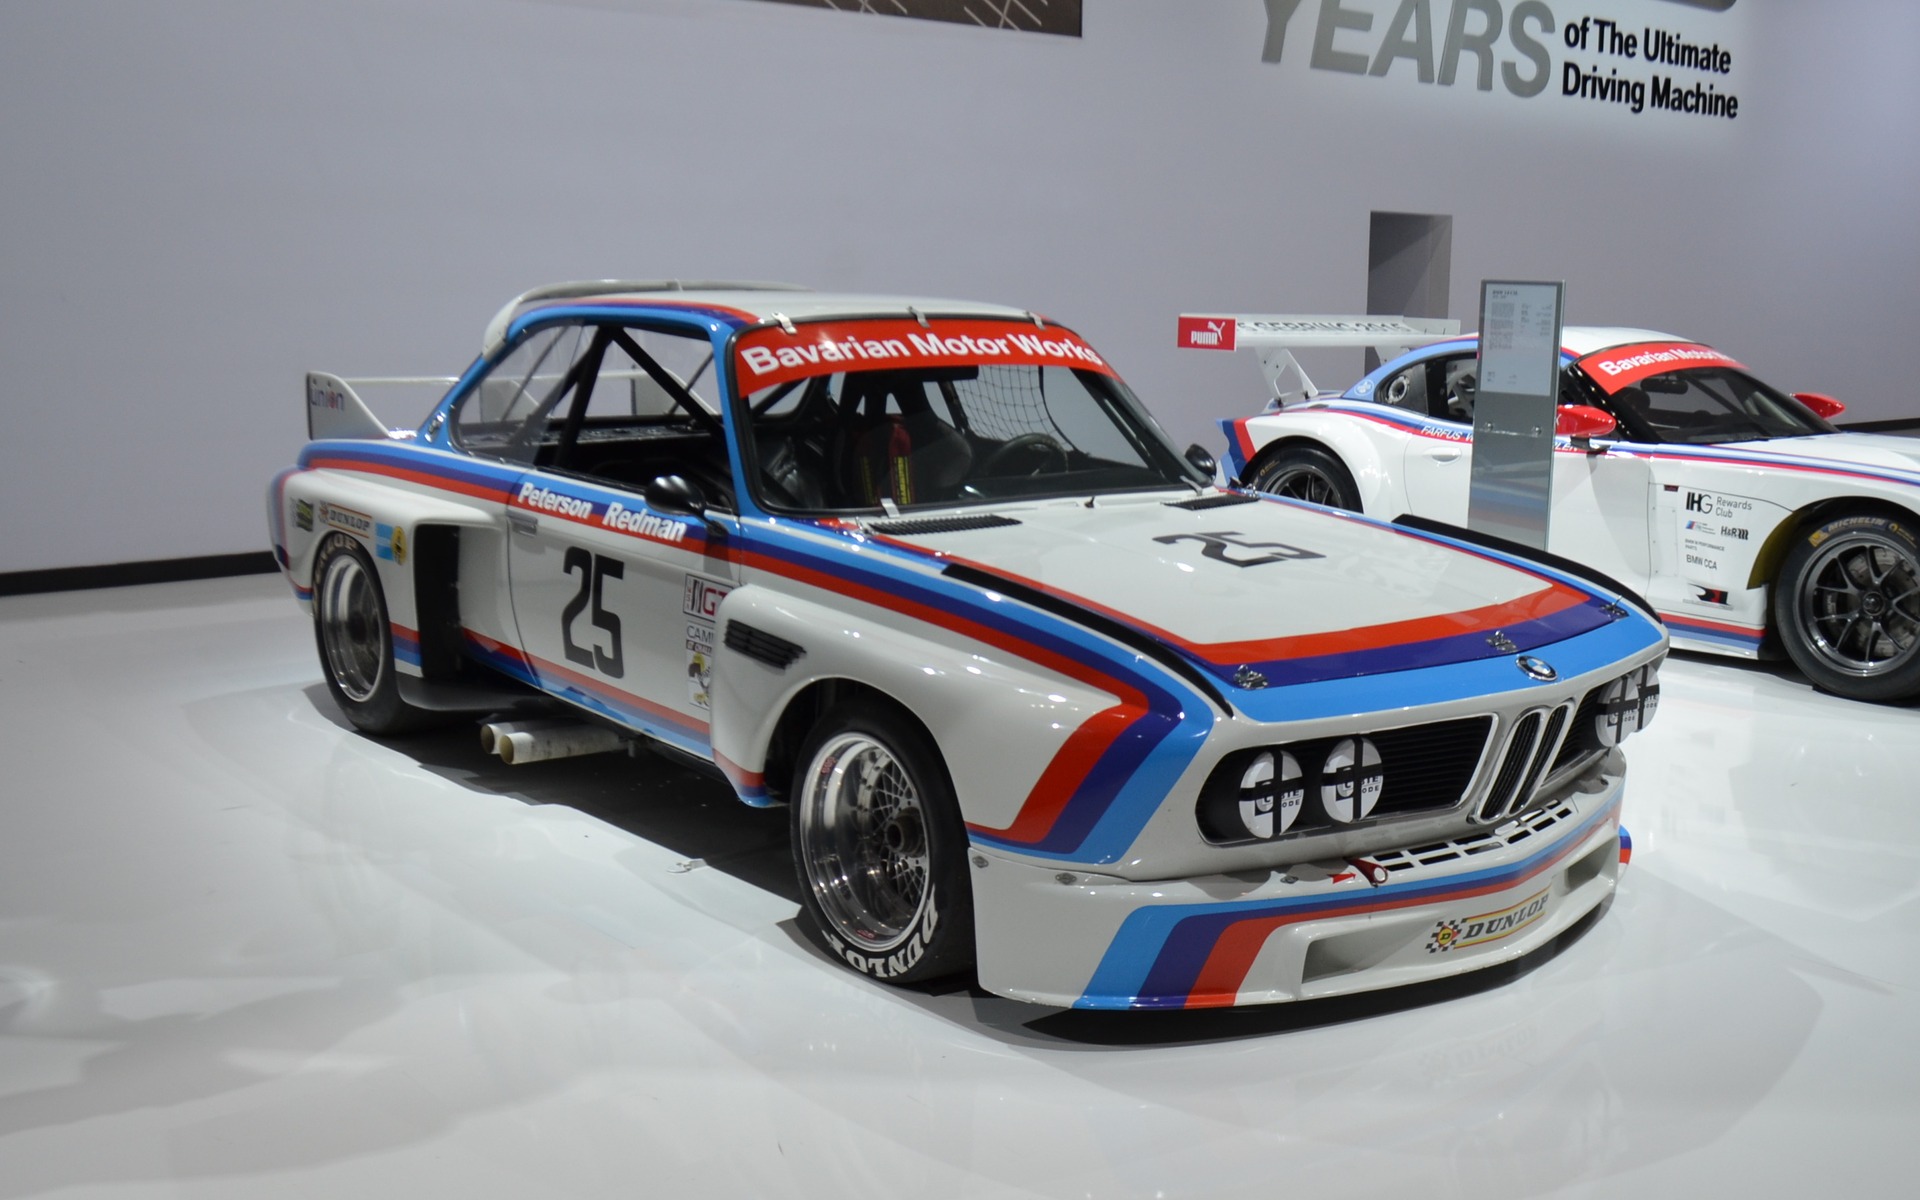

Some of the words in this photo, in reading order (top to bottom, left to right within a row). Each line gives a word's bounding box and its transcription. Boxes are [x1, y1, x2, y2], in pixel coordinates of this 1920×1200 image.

[1261, 0, 1555, 98] YEARS
[1564, 17, 1589, 49] of
[1593, 19, 1638, 59] The
[1643, 27, 1732, 75] Ultimate
[1563, 62, 1645, 114] Driving
[1649, 75, 1738, 119] Machine
[740, 335, 911, 375] Bavarian
[907, 333, 1011, 356] Motor
[1006, 334, 1103, 366] Works
[1191, 331, 1218, 346] PUMA
[1598, 349, 1678, 376] Bavarian
[1421, 425, 1462, 441] FARFUS
[330, 509, 370, 531] DUNLOP
[517, 482, 593, 519] Peterson
[602, 501, 687, 542] Redman
[1686, 491, 1713, 514] IHG
[1716, 496, 1752, 511] Rewards
[1715, 507, 1733, 519] Club
[1827, 516, 1885, 533] MICHELIN
[1152, 531, 1327, 568] 25
[562, 546, 624, 679] 25
[822, 883, 939, 977] DUNLOP
[1462, 892, 1549, 940] DUNLOP
